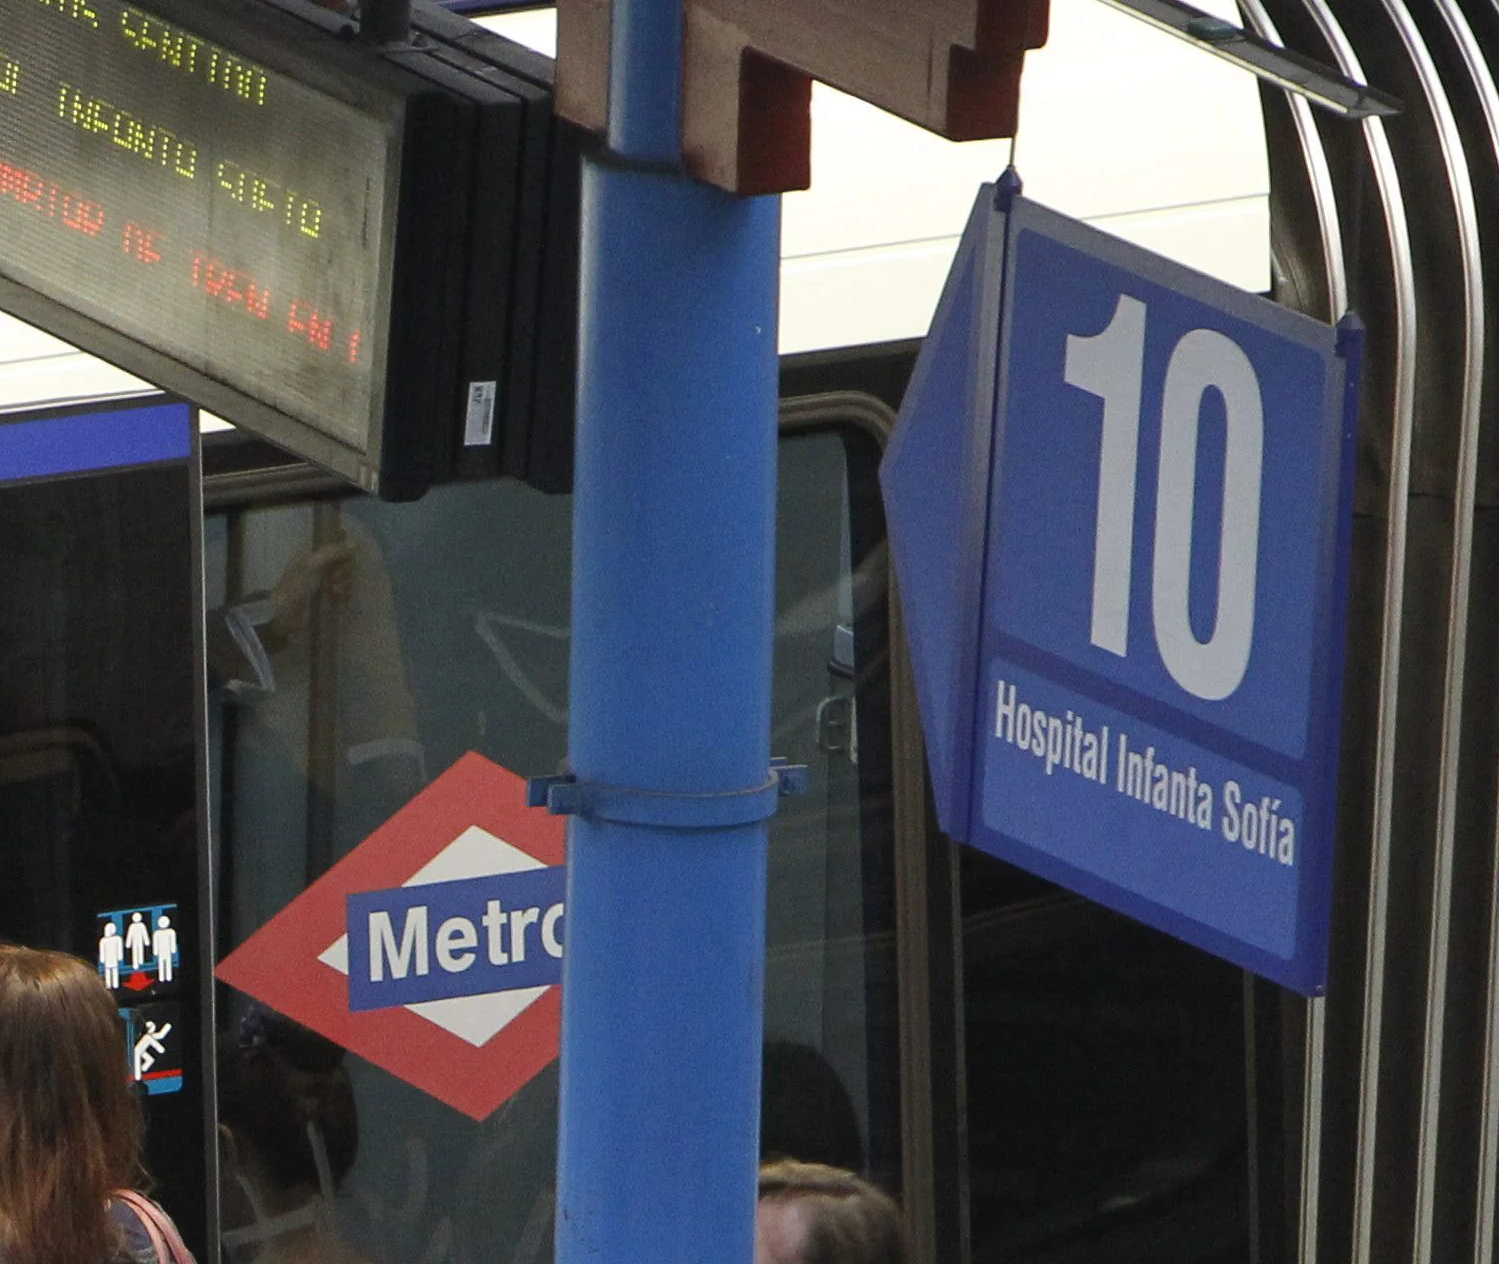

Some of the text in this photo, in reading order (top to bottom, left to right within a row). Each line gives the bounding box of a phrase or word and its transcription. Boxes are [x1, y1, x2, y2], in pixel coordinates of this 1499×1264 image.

[1063, 293, 1265, 702] 10
[994, 679, 1296, 866] Hospital Infanta Sofía
